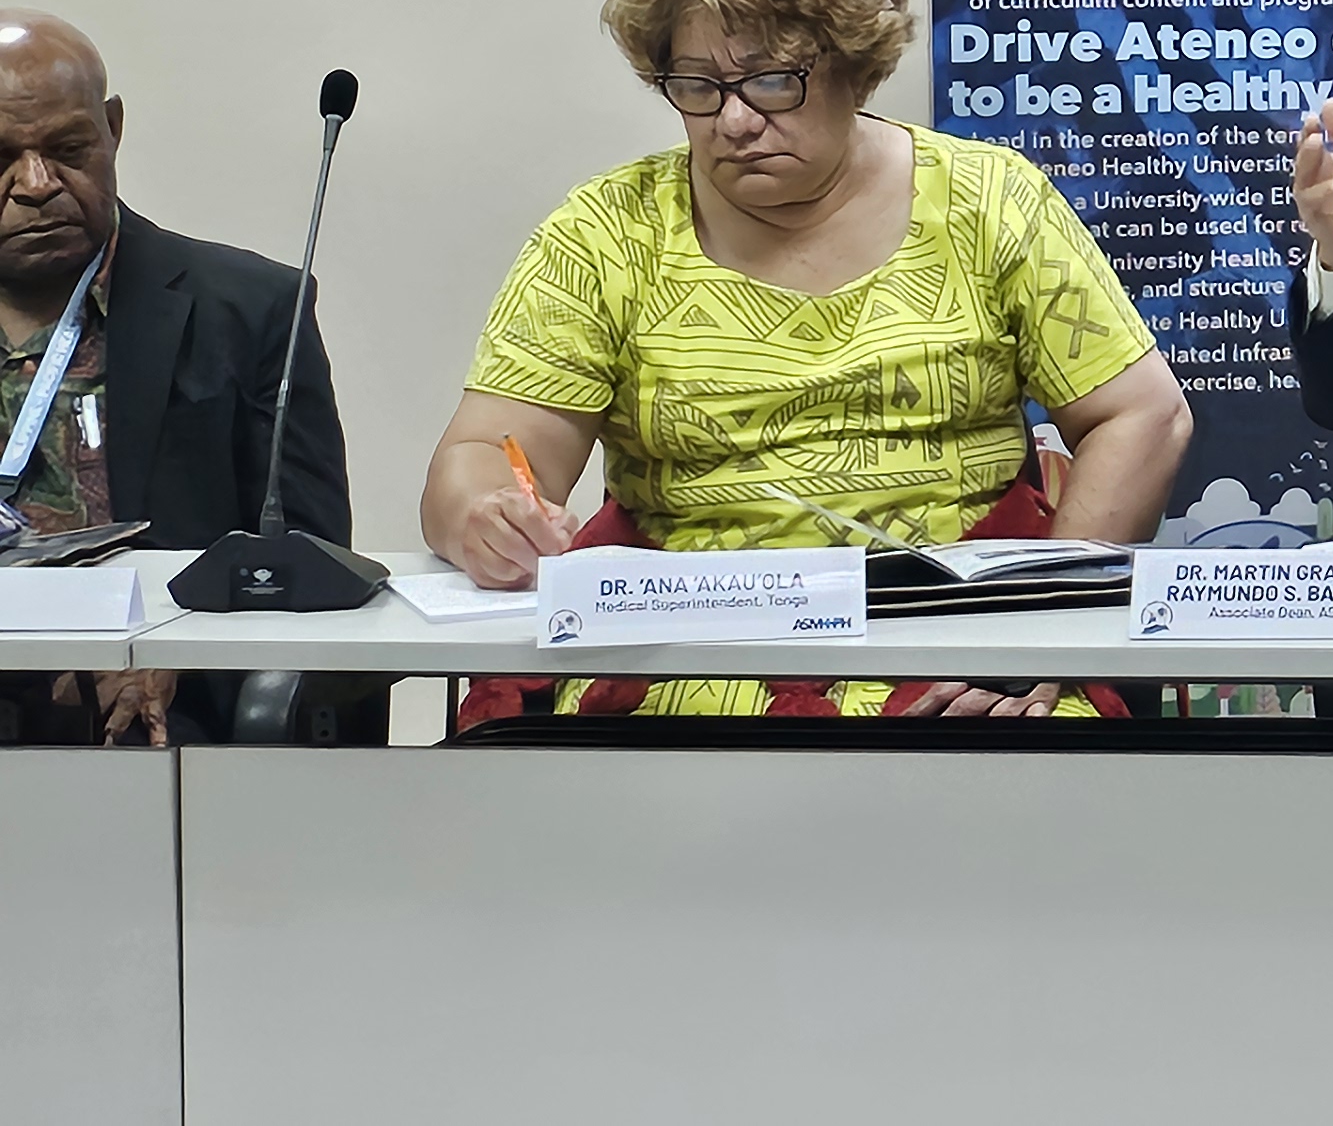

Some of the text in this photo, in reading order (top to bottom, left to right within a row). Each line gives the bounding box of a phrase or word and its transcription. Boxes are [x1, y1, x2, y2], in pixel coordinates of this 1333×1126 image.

[950, 20, 1102, 64] Drive
[1116, 21, 1317, 62] Ateneo
[949, 72, 1333, 122] to be a Healthy
[1099, 129, 1192, 147] creation
[1226, 126, 1261, 145] the
[1103, 156, 1186, 178] Healthy
[1094, 186, 1265, 211] University-wide
[1116, 216, 1284, 238] can be used for
[1210, 248, 1281, 269] Health
[1142, 277, 1285, 298] and structure
[1179, 309, 1270, 335] Healthy
[1176, 565, 1207, 581] DR.
[1214, 565, 1290, 581] MARTIN
[600, 579, 633, 596] DR.
[1167, 585, 1278, 602] RAYMUNDO
[1284, 585, 1301, 602] S.
[595, 601, 648, 613] Medical
[1208, 607, 1275, 618] Associate
